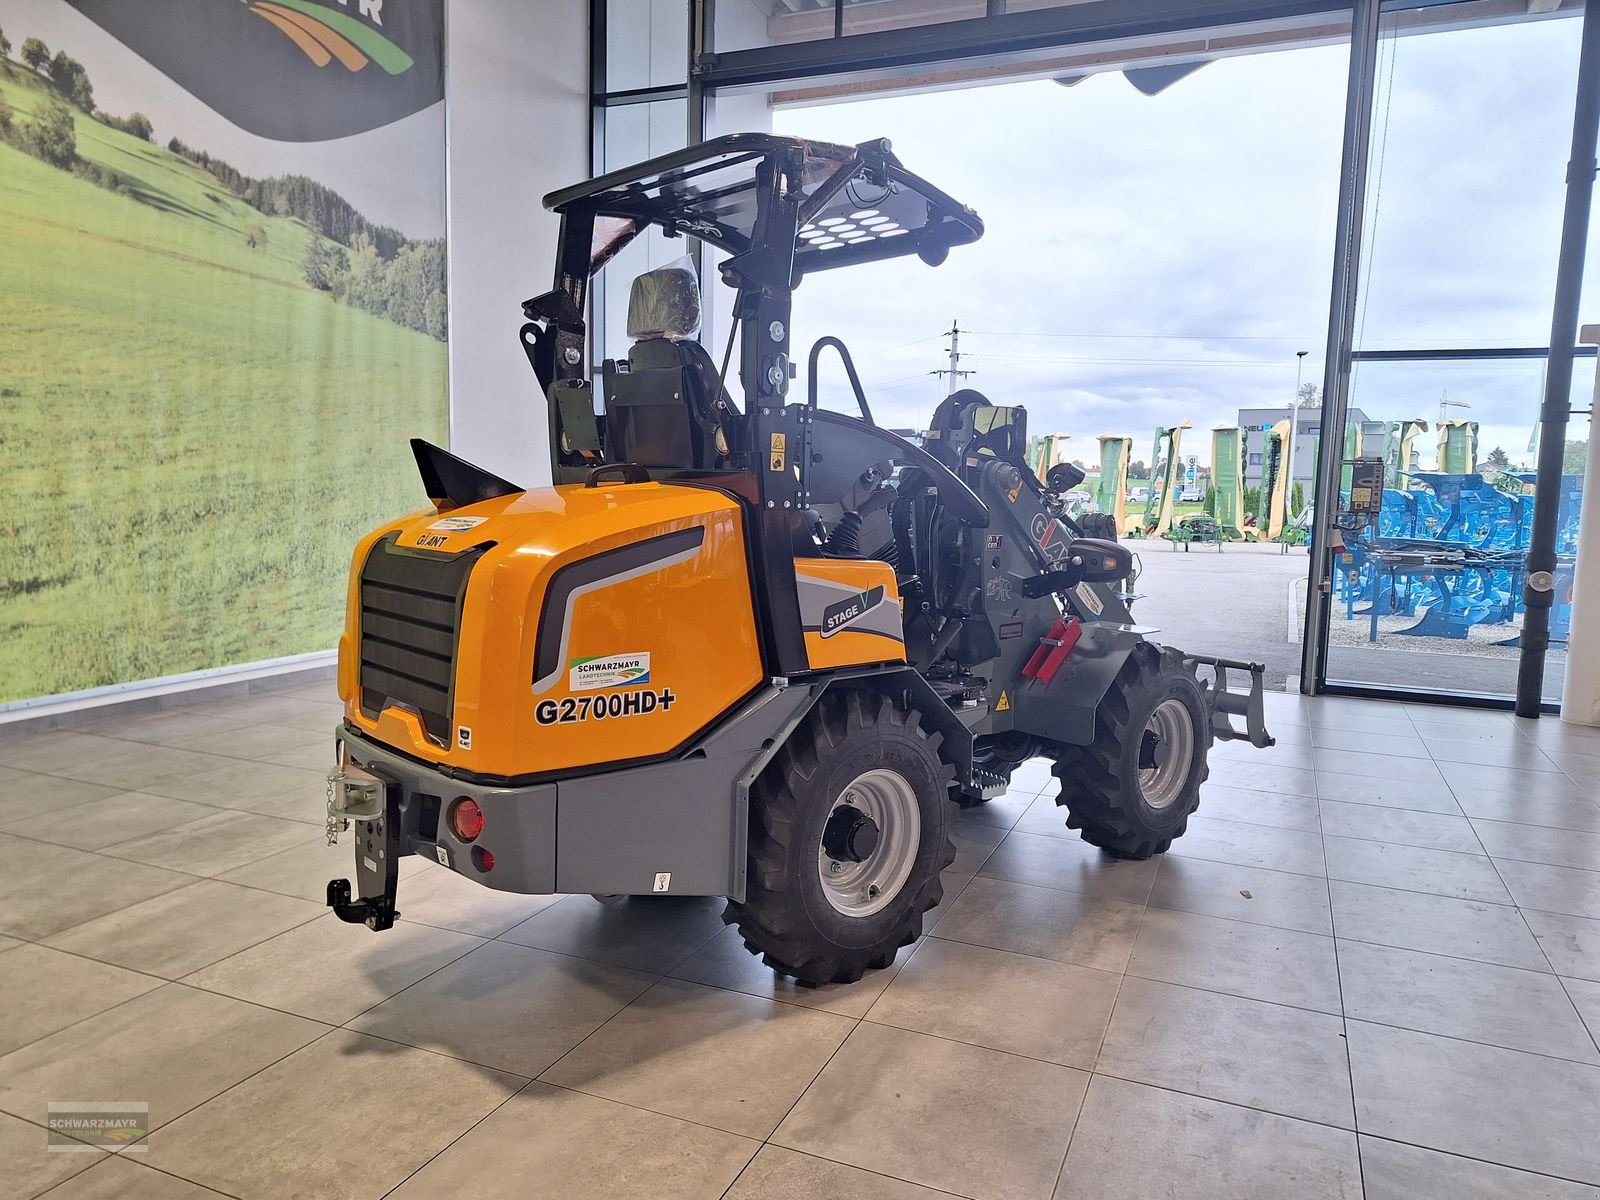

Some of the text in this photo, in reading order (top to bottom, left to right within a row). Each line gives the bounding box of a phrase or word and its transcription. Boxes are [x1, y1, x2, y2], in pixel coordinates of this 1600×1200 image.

[416, 531, 449, 548] GIANT
[827, 604, 859, 628] STAGE
[577, 660, 640, 673] SCHWARZMAYR
[579, 672, 616, 680] LANDTECHNIK
[535, 688, 676, 726] G2700HD+
